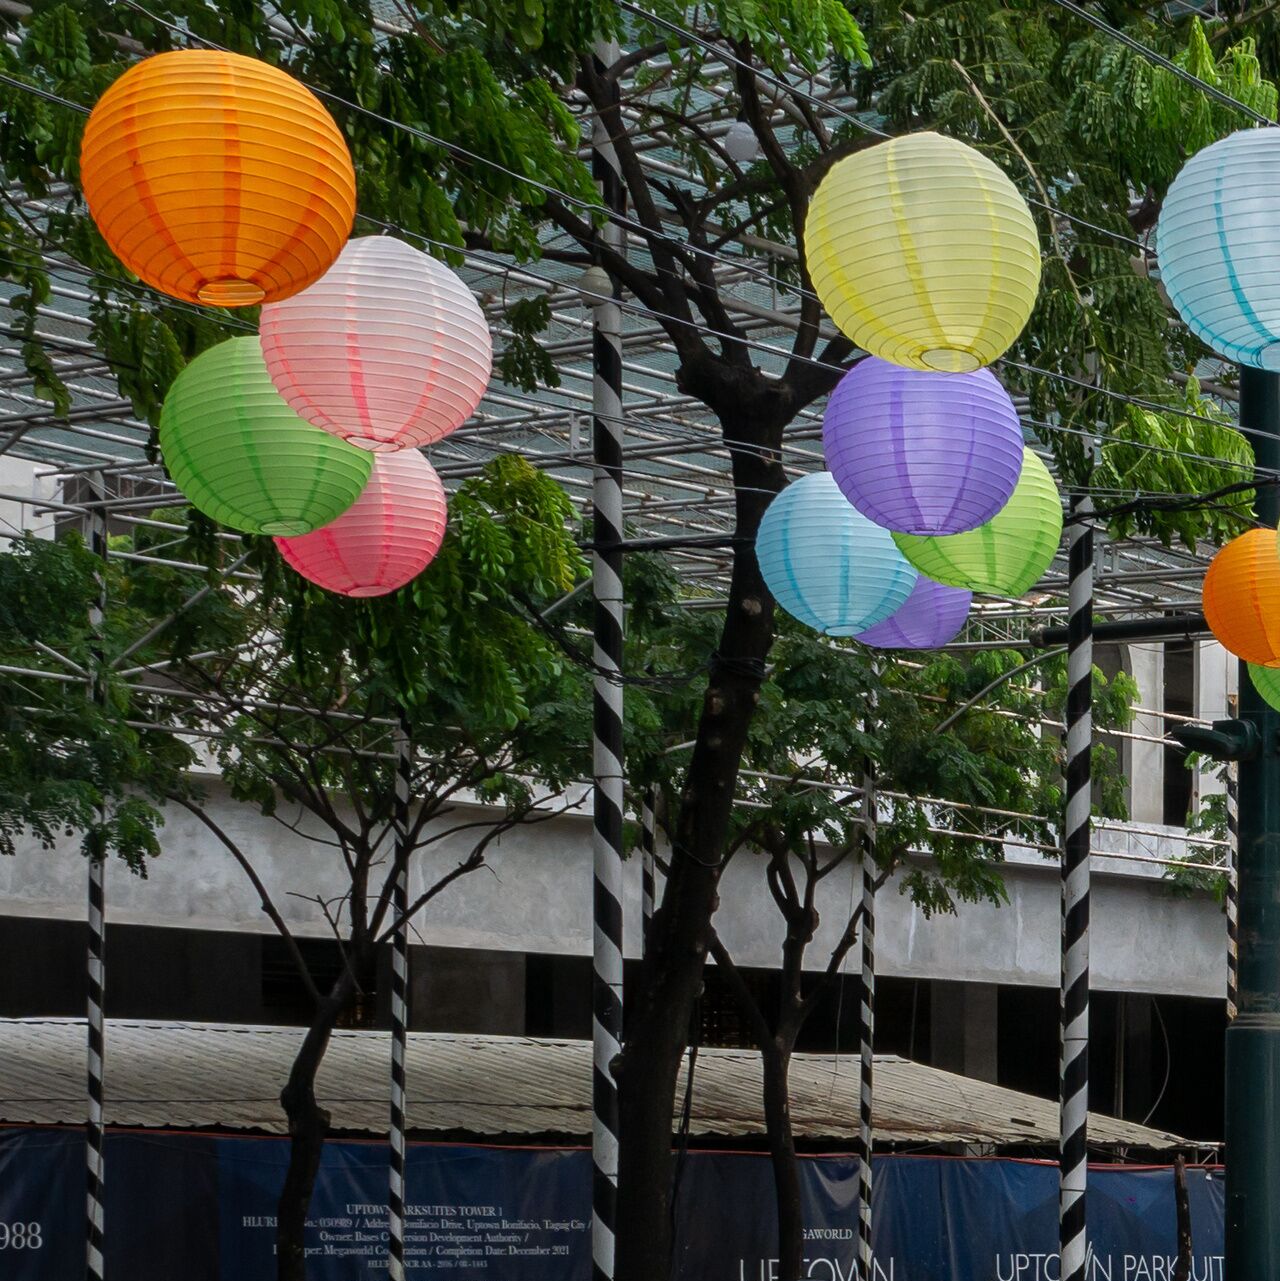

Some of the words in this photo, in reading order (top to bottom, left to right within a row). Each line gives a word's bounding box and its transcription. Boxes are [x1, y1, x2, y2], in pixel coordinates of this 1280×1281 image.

[402, 1205, 457, 1216] ARKSUITES
[458, 1206, 497, 1217] TOWER
[498, 1207, 503, 1217] 1
[363, 1218, 390, 1229] Addre
[467, 1219, 500, 1232] Uptown
[502, 1219, 541, 1230] Bonifacio,
[355, 1231, 379, 1242] Bases
[429, 1232, 483, 1245] Development
[484, 1232, 521, 1245] Authority
[803, 1228, 853, 1240] AWORLD
[323, 1244, 374, 1258] Megaworld
[436, 1245, 484, 1259] Completion
[508, 1245, 551, 1256] December
